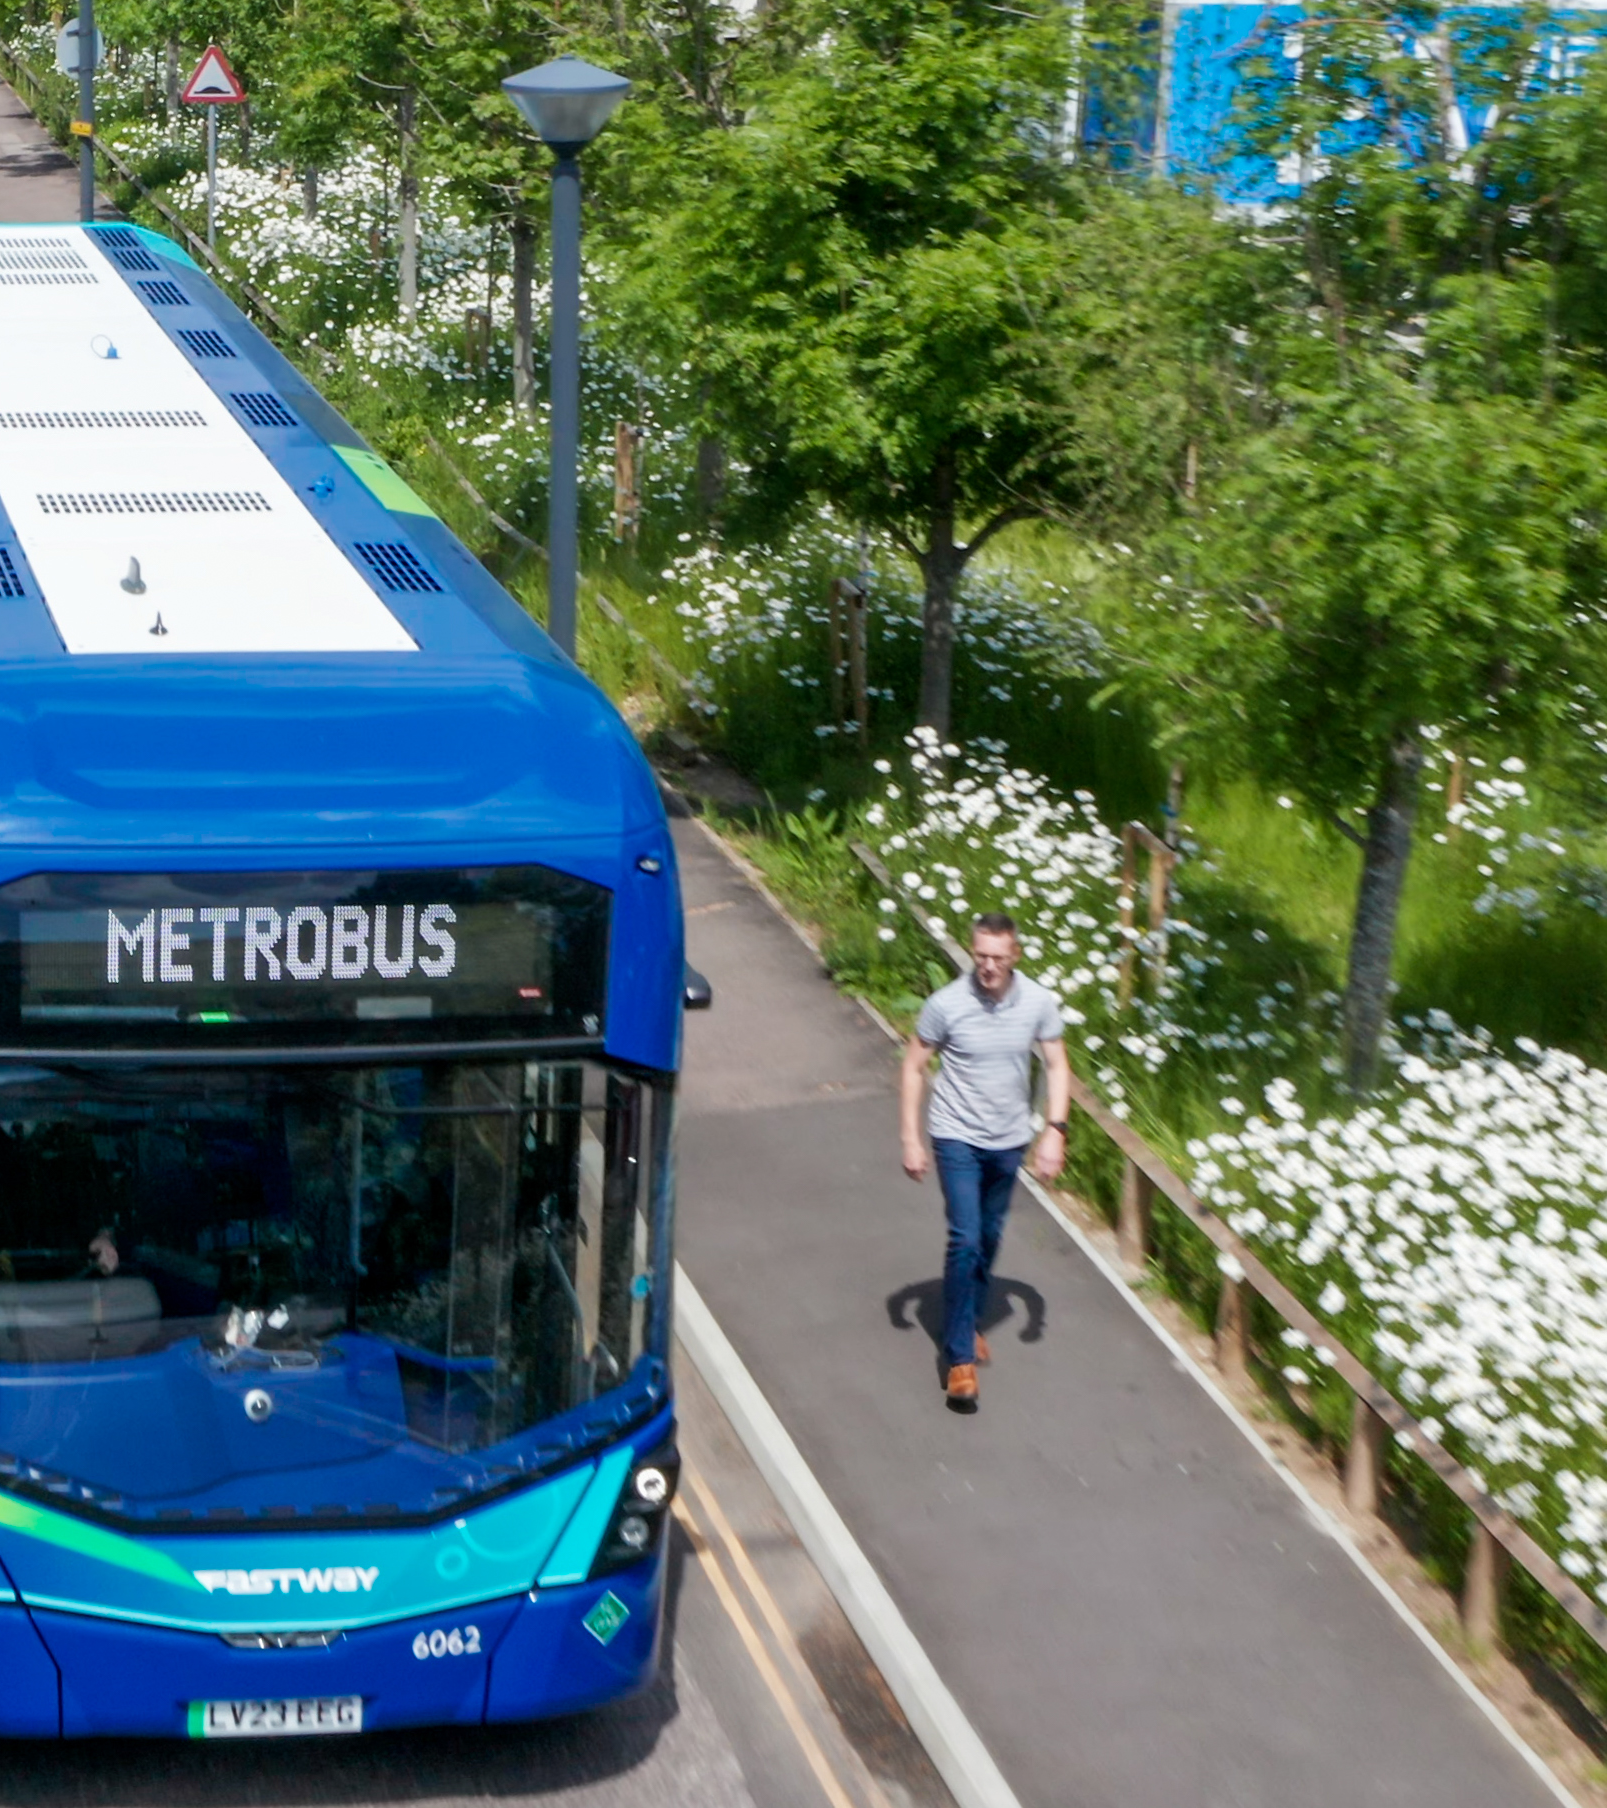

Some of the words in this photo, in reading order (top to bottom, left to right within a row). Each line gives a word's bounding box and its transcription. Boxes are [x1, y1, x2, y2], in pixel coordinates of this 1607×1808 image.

[107, 904, 456, 983] METROBUS
[412, 1625, 481, 1660] 6062
[209, 1701, 287, 1730] LV23
[297, 1699, 354, 1726] EEG
